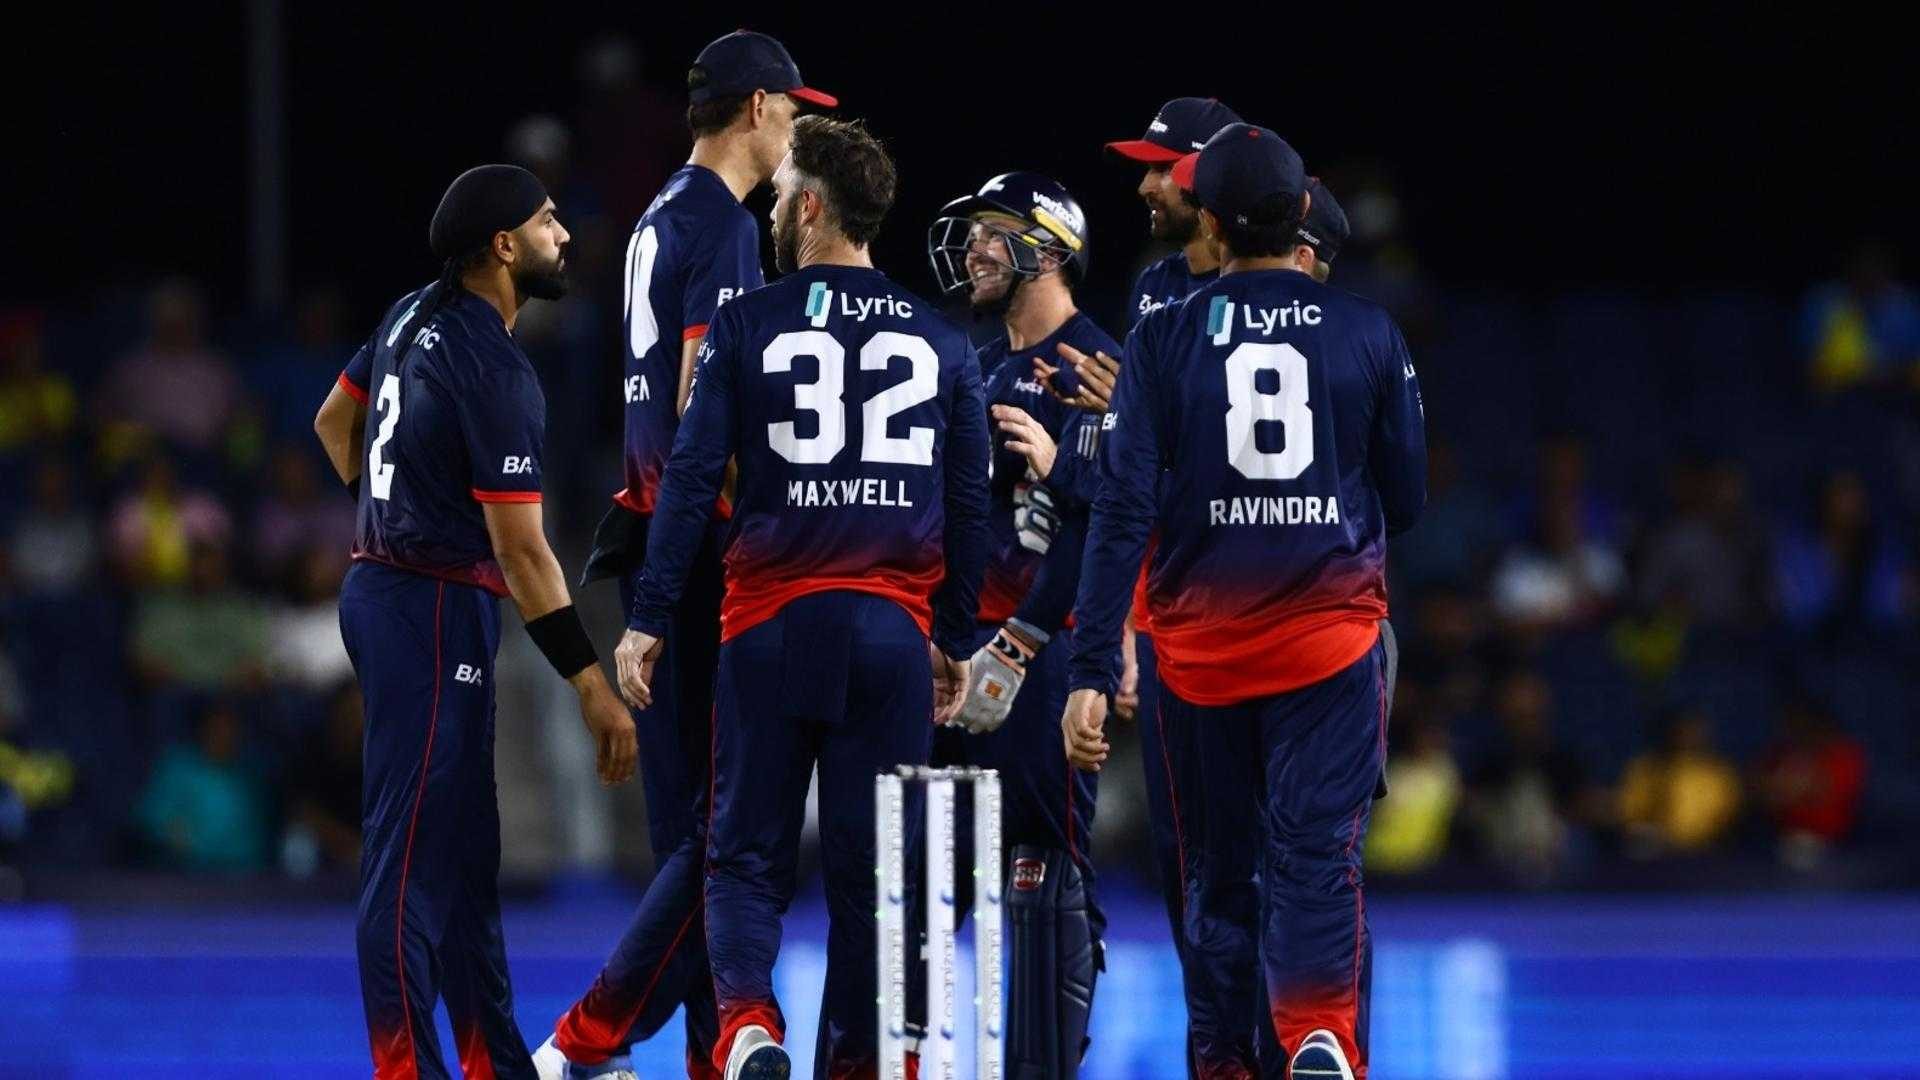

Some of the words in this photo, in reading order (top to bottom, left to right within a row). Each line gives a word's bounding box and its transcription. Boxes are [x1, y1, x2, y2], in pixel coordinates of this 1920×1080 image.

[840, 292, 913, 321] Lyric
[1243, 299, 1322, 336] Lyric
[414, 324, 441, 350] ric
[762, 331, 939, 467] 32
[1224, 342, 1315, 480] 8
[368, 373, 401, 501] 2
[787, 479, 913, 508] MAXWELL
[1209, 496, 1340, 526] RAVINDRA
